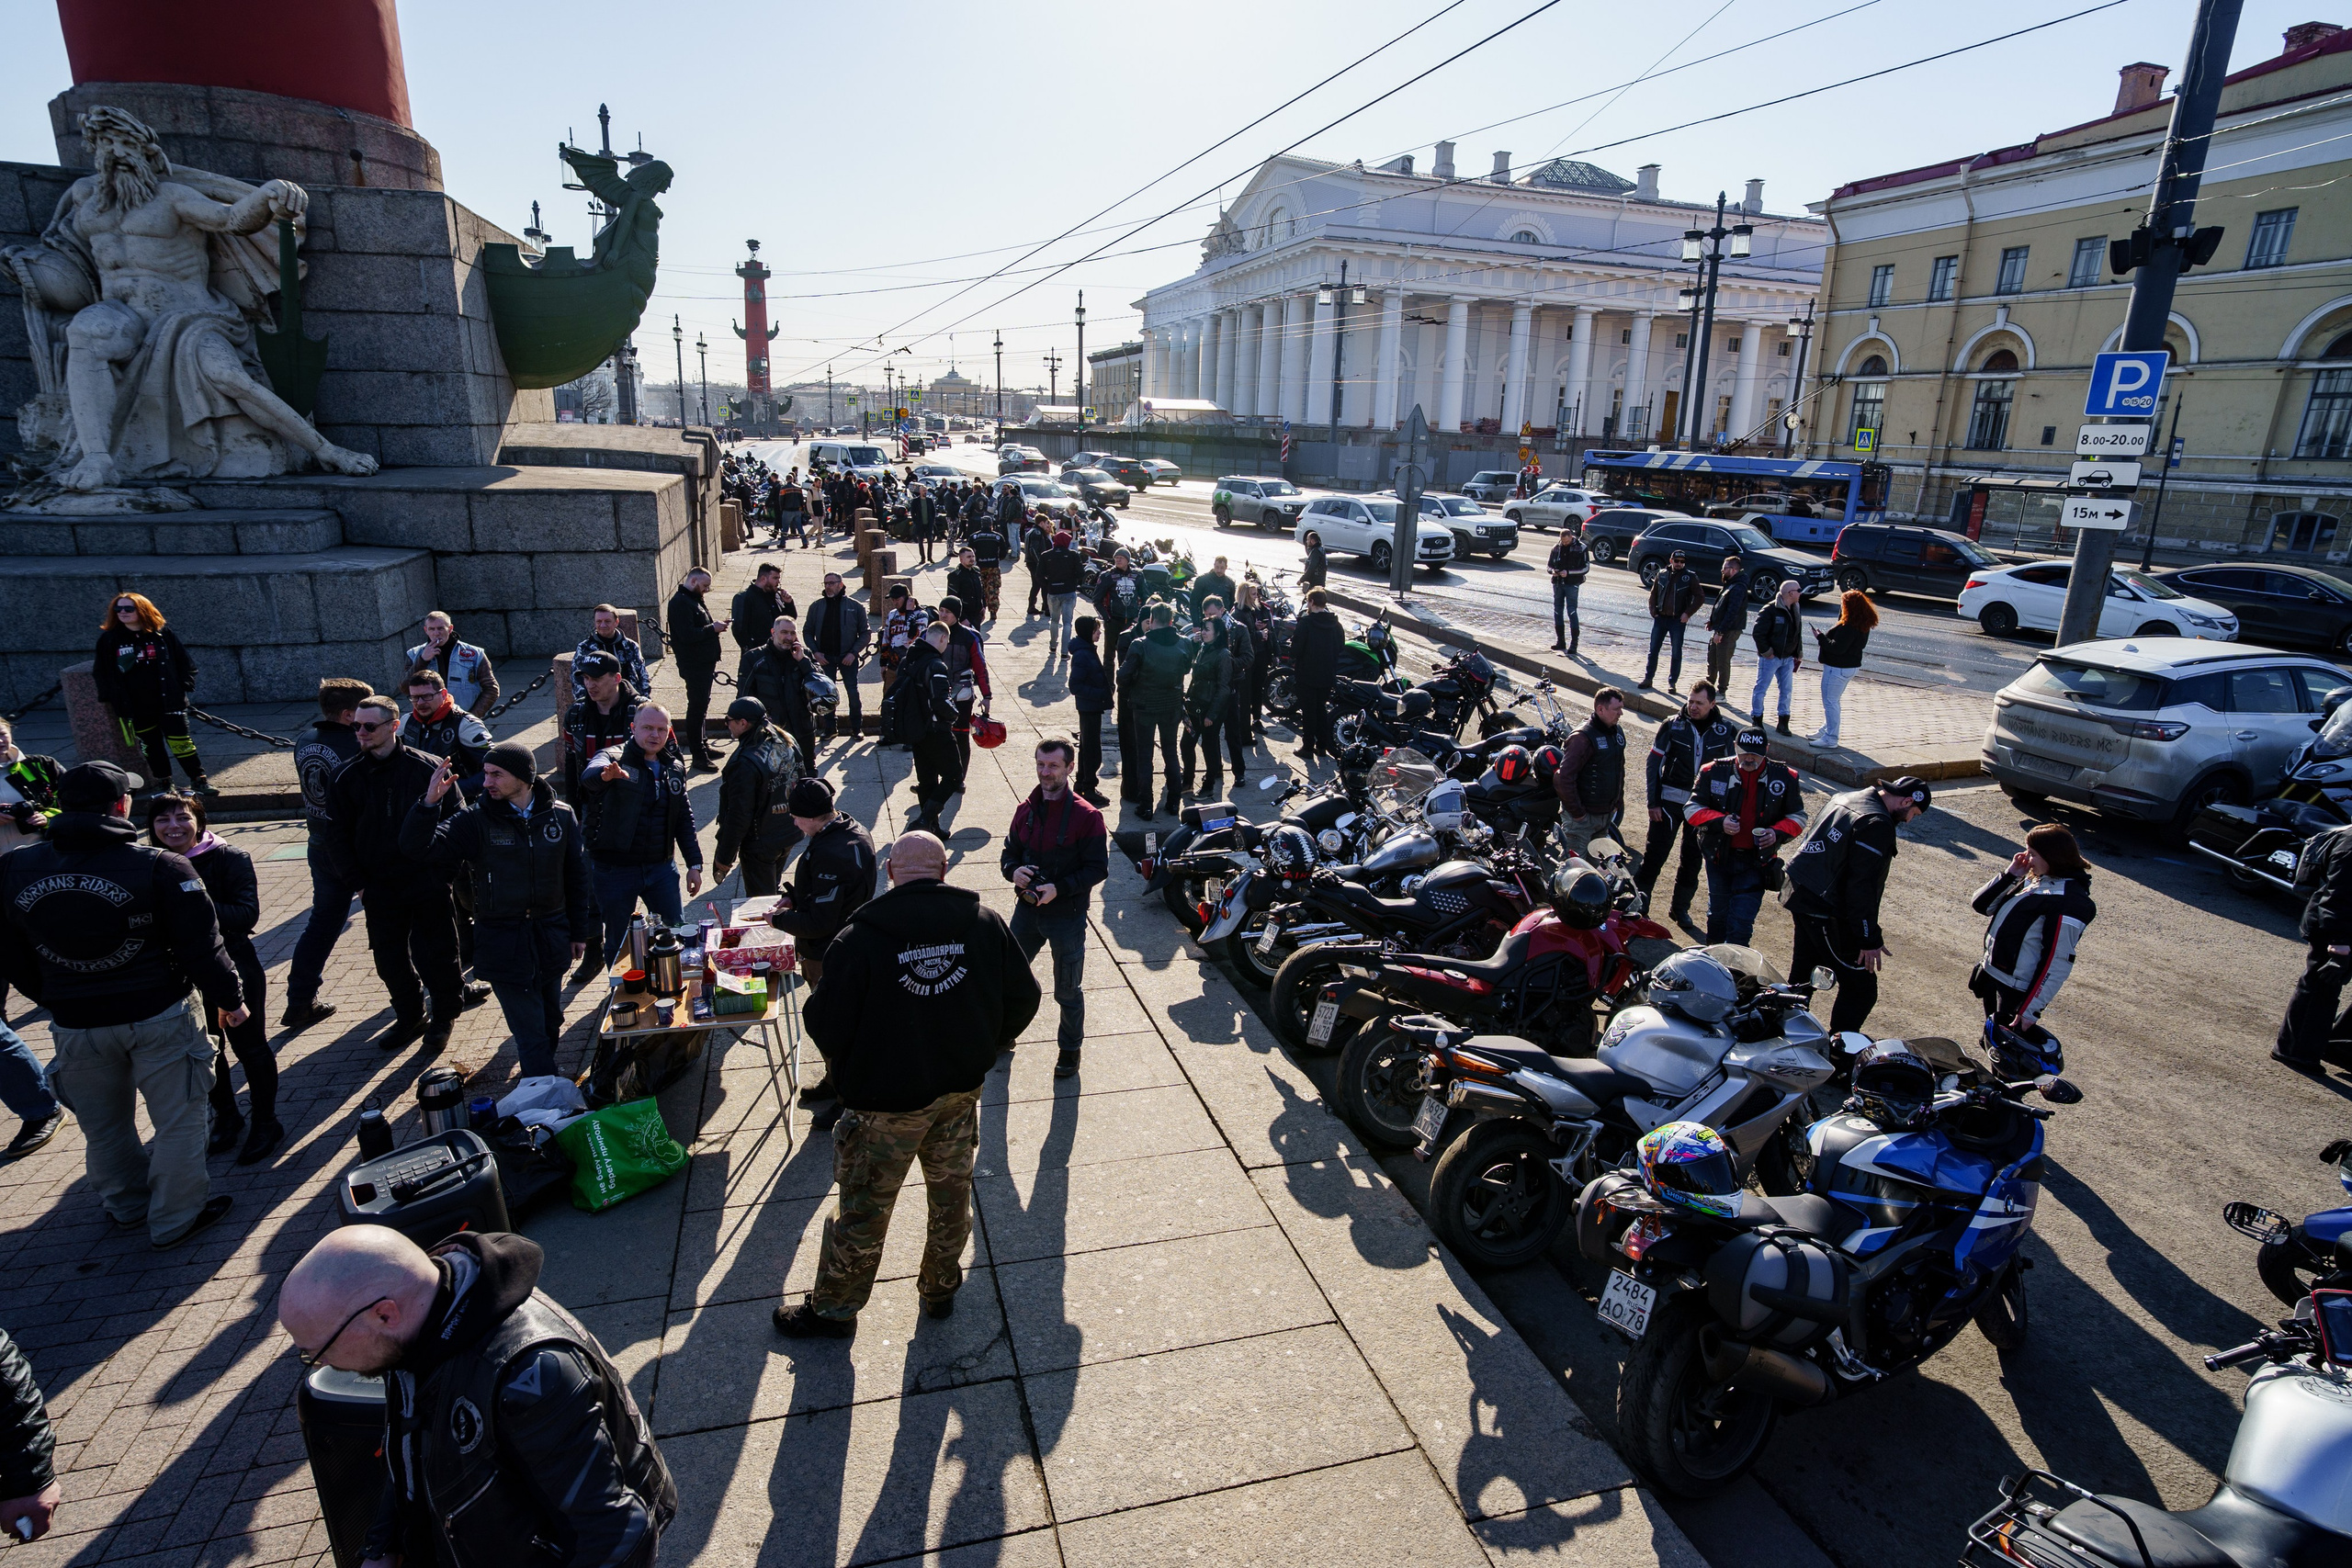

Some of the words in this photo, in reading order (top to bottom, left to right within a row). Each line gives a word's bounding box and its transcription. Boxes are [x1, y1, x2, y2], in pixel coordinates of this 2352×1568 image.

[2105, 360, 2151, 409] P
[2141, 398, 2152, 406] 20
[2080, 434, 2144, 446] 8.00-20.00
[1739, 734, 1764, 745] NRMC
[2007, 719, 2047, 739] NORMANS
[2052, 730, 2091, 749] RIDERS
[2097, 739, 2112, 753] MC
[322, 748, 341, 768] RIDERS
[1829, 829, 1841, 840] MC
[818, 873, 838, 881] LS2
[17, 875, 75, 908] NORMANS
[79, 877, 128, 903] RIDERS
[130, 914, 151, 926] MC
[897, 943, 965, 964] МОТОЗАПОЛЯРНИК
[923, 957, 942, 966] РОССИЯ
[899, 974, 931, 996] РУССКАЯ
[934, 965, 968, 995] АРКТИКА
[1317, 1005, 1335, 1020] 5723
[586, 1133, 598, 1158] пакет
[592, 1119, 608, 1157] природу
[594, 1159, 604, 1181] беру
[603, 1157, 616, 1190] берегу
[599, 1181, 607, 1194] не
[1666, 1188, 1687, 1203] SHOEI
[1612, 1275, 1650, 1305] 2484
[1626, 1299, 1639, 1311] RUS
[440, 1314, 463, 1340] SUPPORT
[1626, 1308, 1645, 1331] 78
